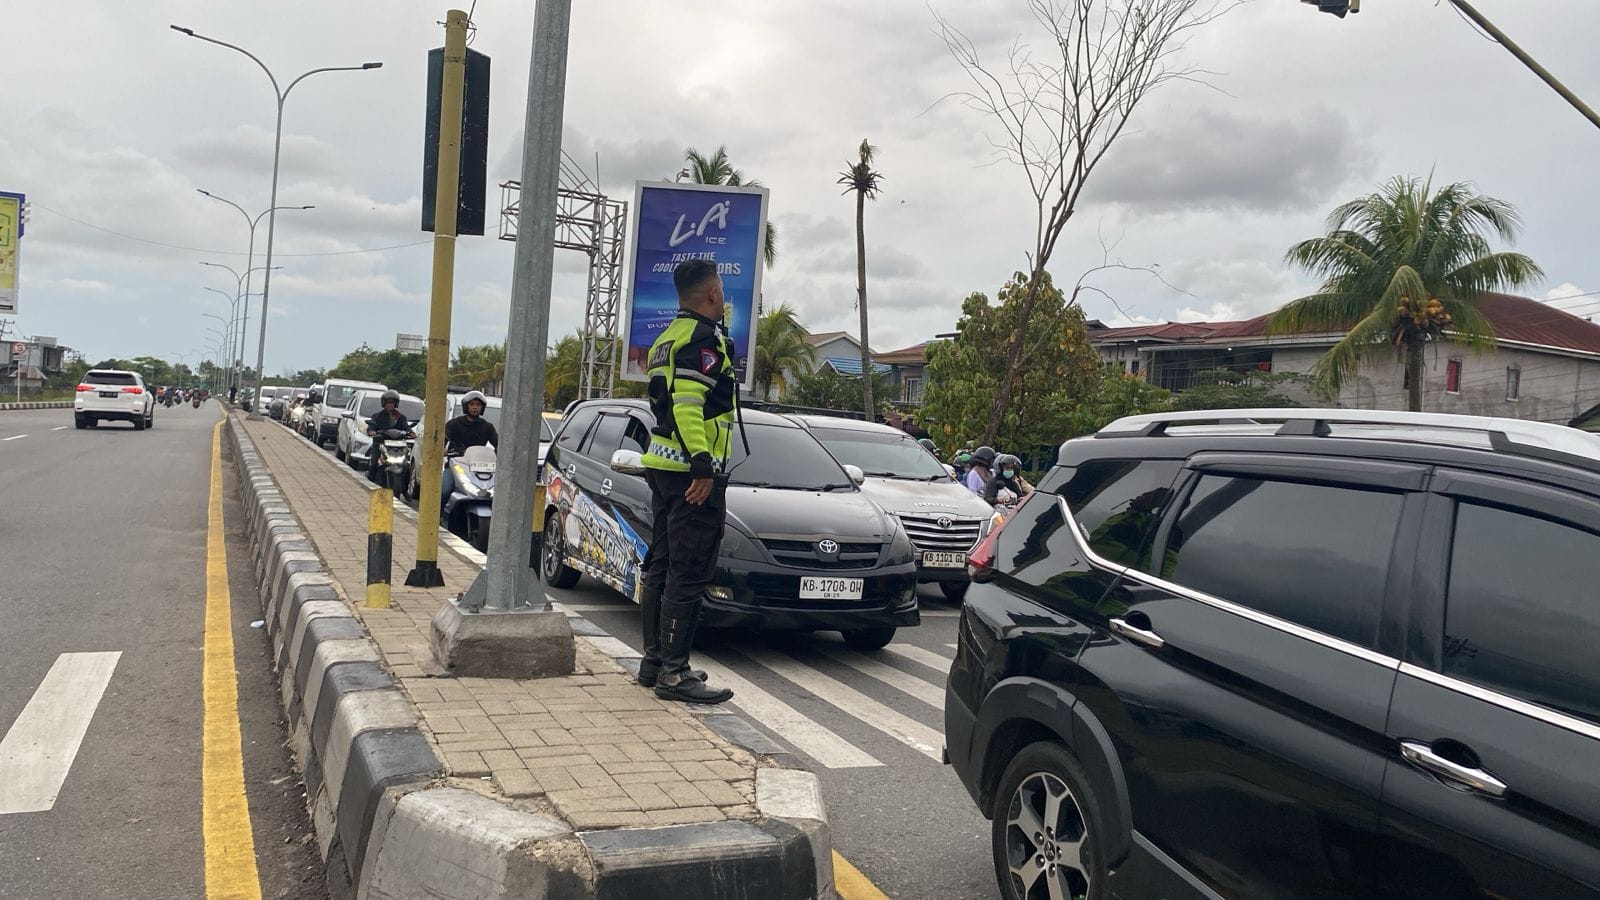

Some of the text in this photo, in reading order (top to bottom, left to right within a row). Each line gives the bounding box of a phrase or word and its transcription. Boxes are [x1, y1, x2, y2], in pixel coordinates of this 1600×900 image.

[705, 236, 727, 245] ICE
[671, 252, 716, 263] TASTE THE
[924, 553, 965, 563] KB 1101 GL
[802, 579, 815, 592] KB
[820, 579, 845, 593] 1708
